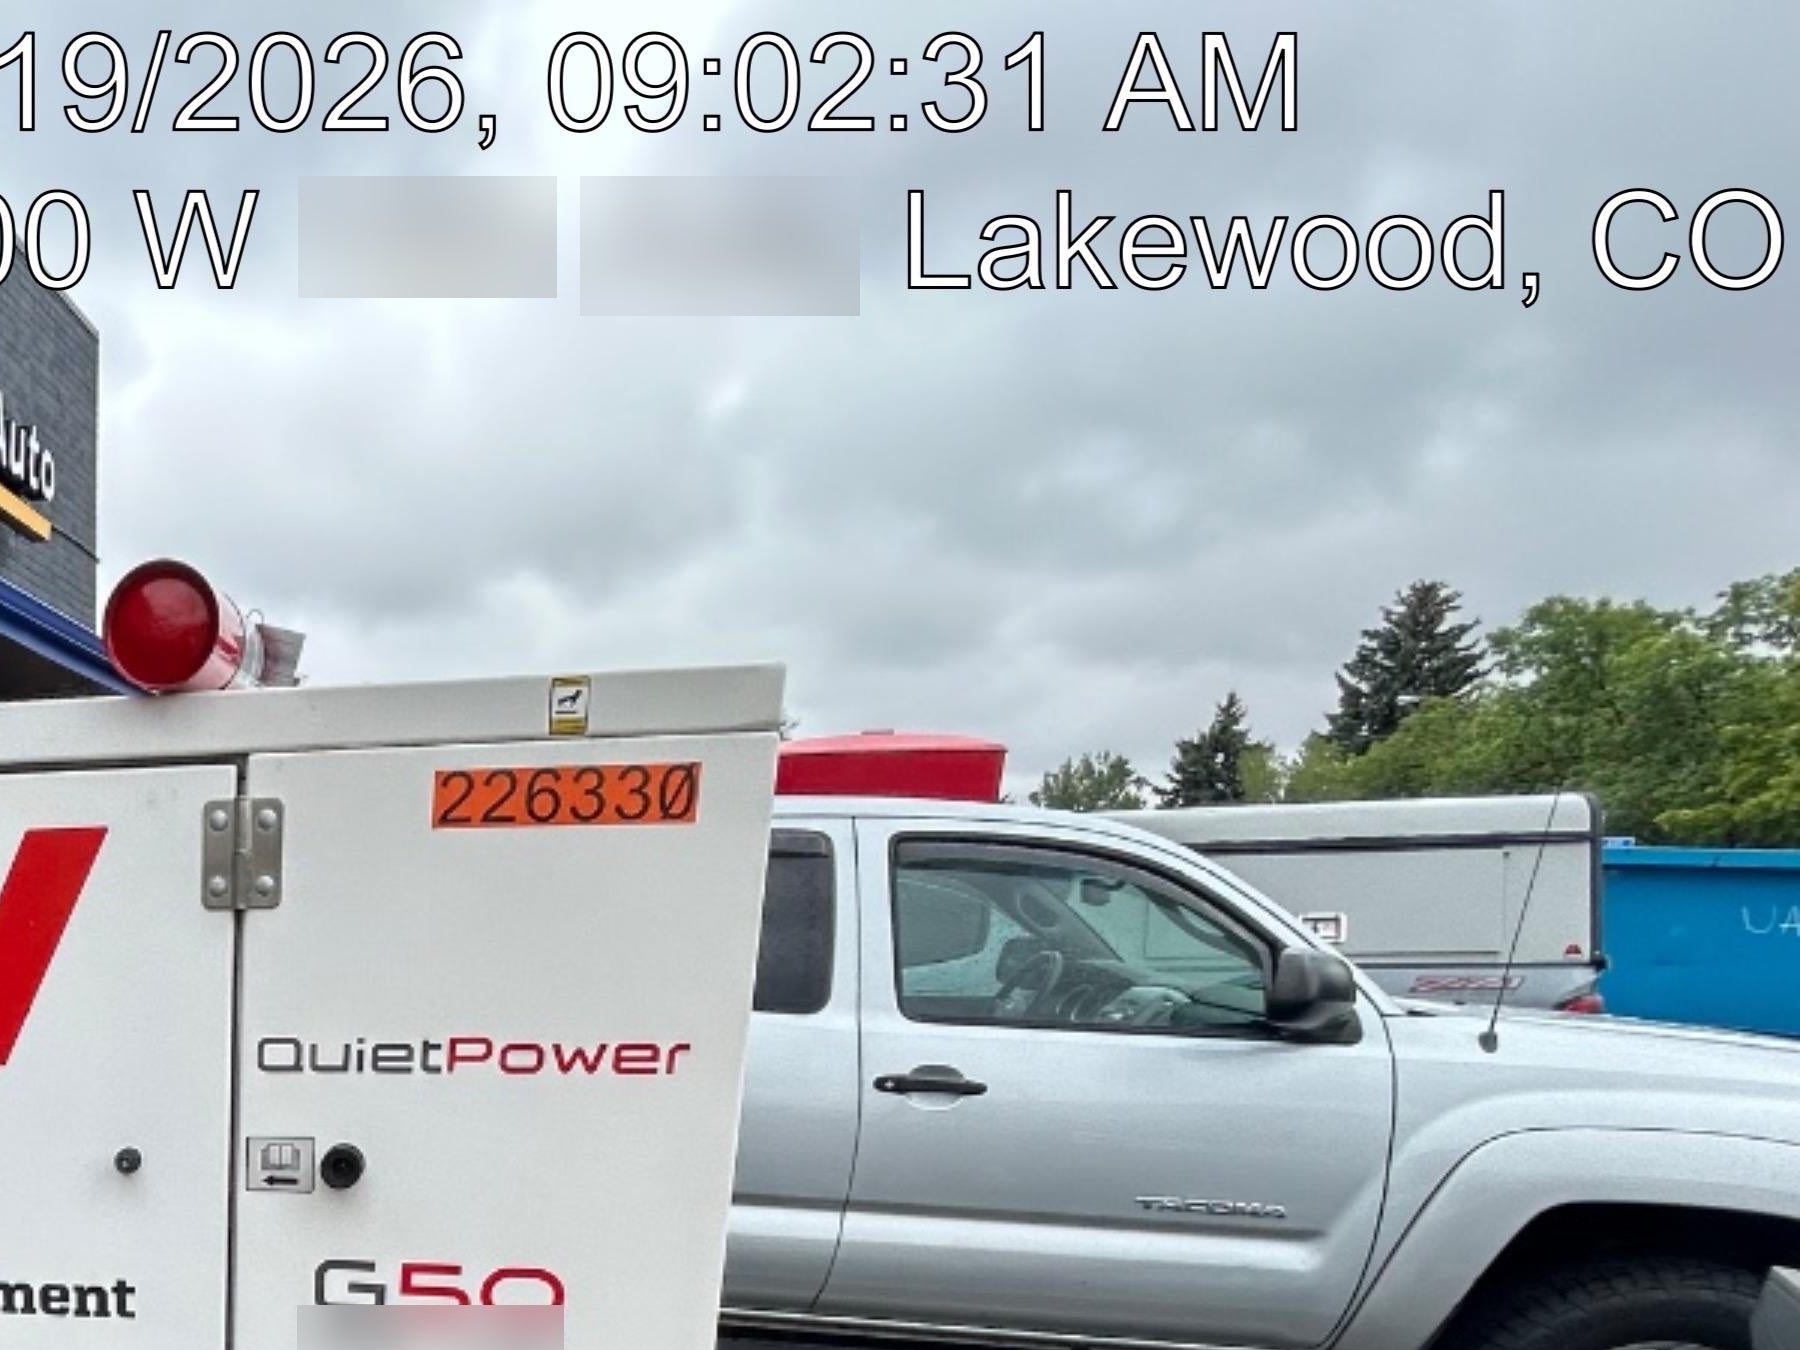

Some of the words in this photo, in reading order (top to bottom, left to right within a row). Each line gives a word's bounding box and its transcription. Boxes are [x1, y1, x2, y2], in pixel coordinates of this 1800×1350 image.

[436, 764, 699, 824] 226330
[256, 1037, 692, 1076] QuietPower
[1134, 1195, 1287, 1219] TACOMA
